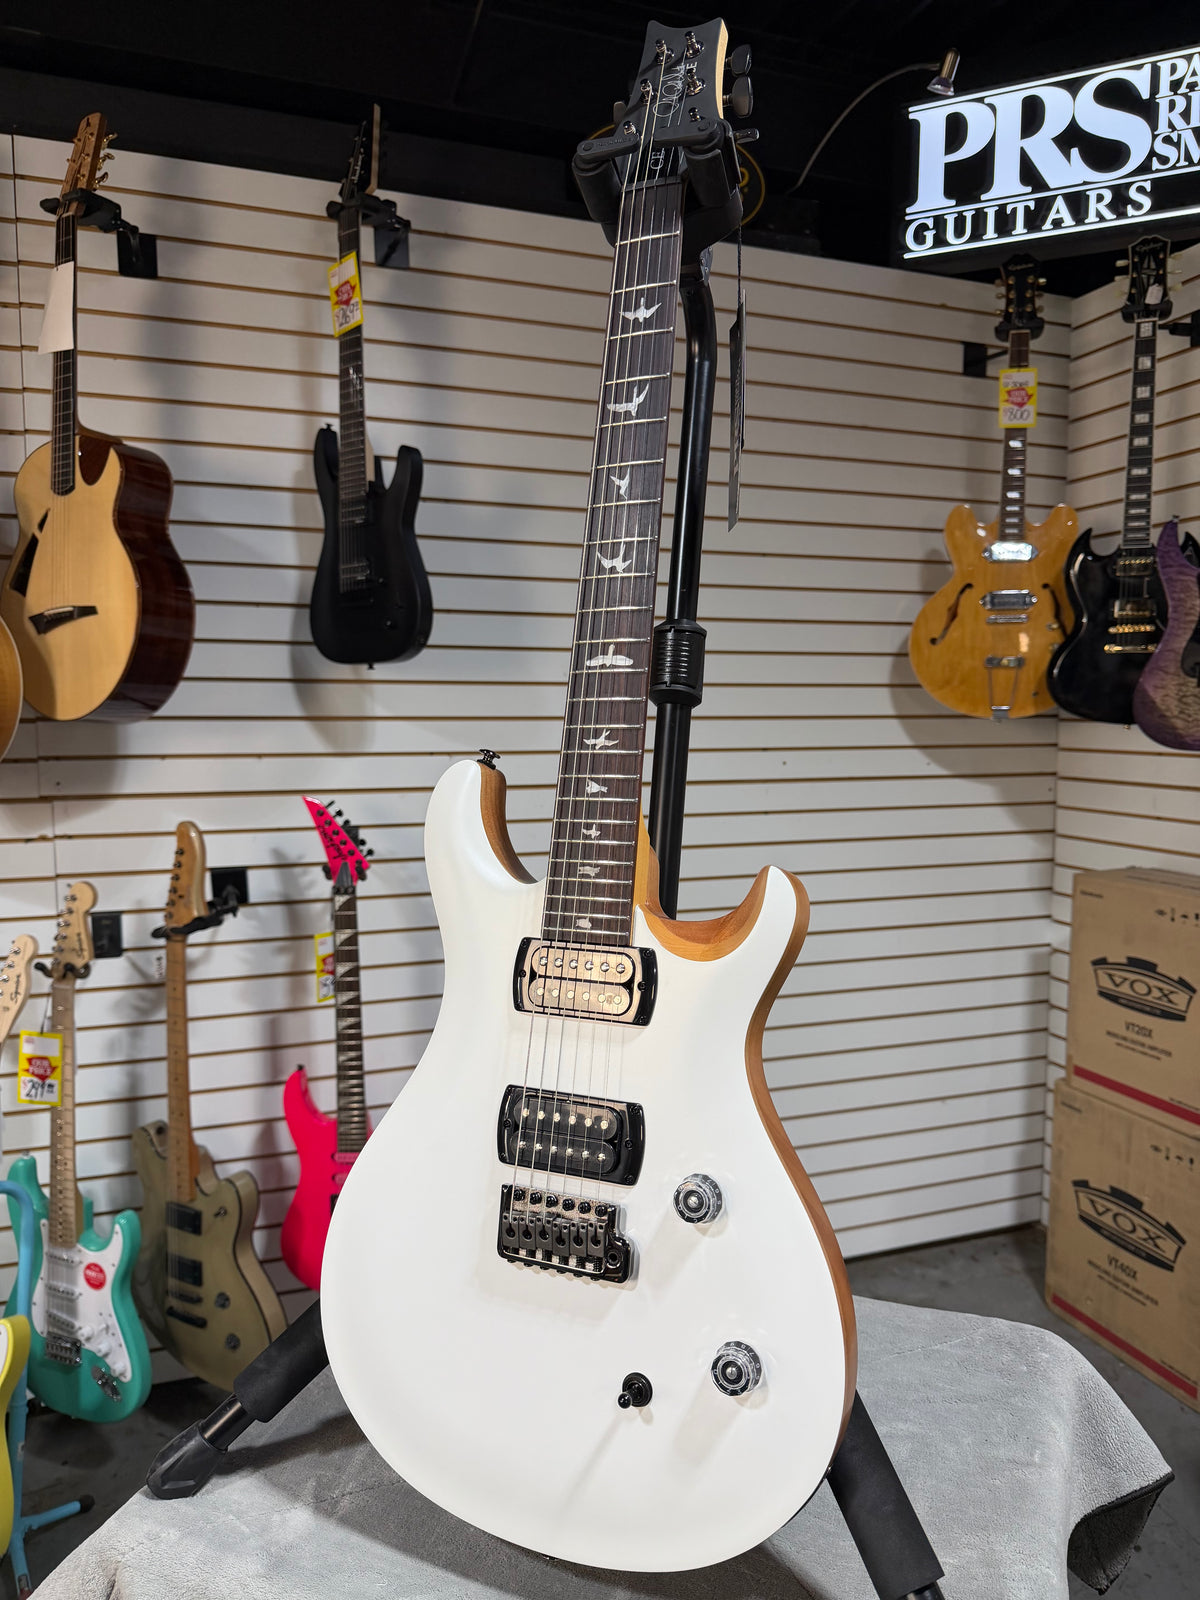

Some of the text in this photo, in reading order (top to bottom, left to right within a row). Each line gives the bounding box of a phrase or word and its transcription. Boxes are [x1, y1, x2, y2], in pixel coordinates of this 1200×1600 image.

[906, 63, 1152, 214] PRS
[905, 180, 1152, 252] GUITARS
[1104, 971, 1179, 1006] VOX
[1085, 1196, 1167, 1253] VOX
